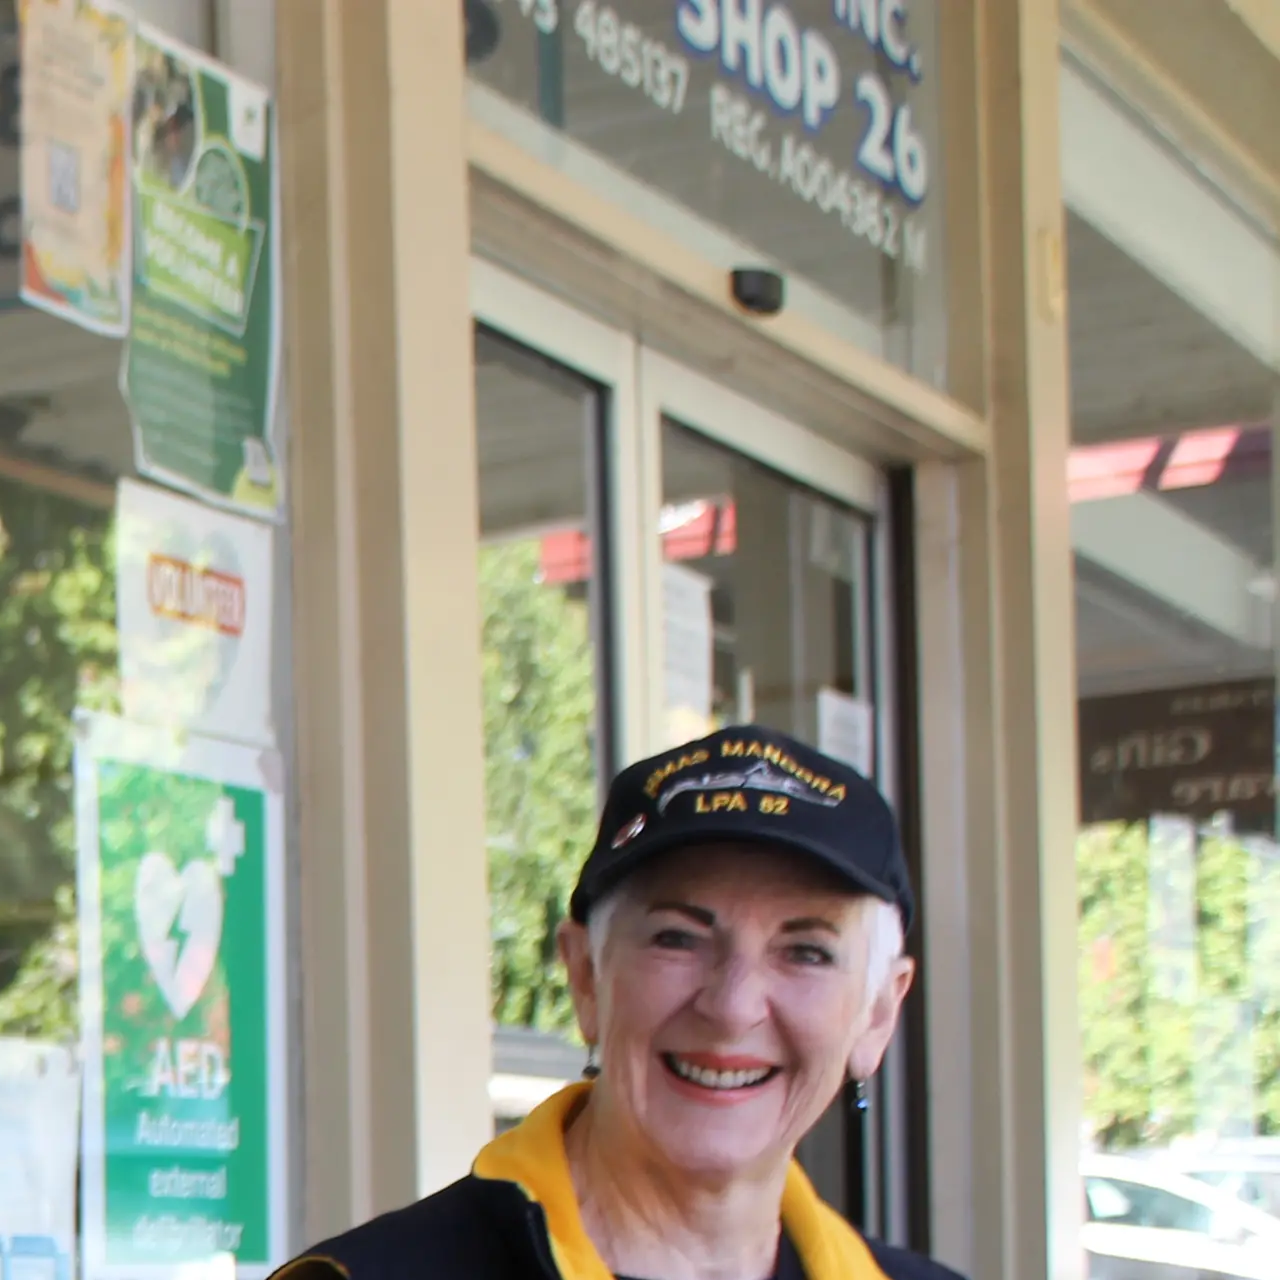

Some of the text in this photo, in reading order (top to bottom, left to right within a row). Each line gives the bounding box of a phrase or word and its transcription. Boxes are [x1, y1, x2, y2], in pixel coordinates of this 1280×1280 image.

[676, 0, 927, 201] SHOP 26
[694, 790, 748, 814] LPA
[144, 1036, 227, 1100] AED
